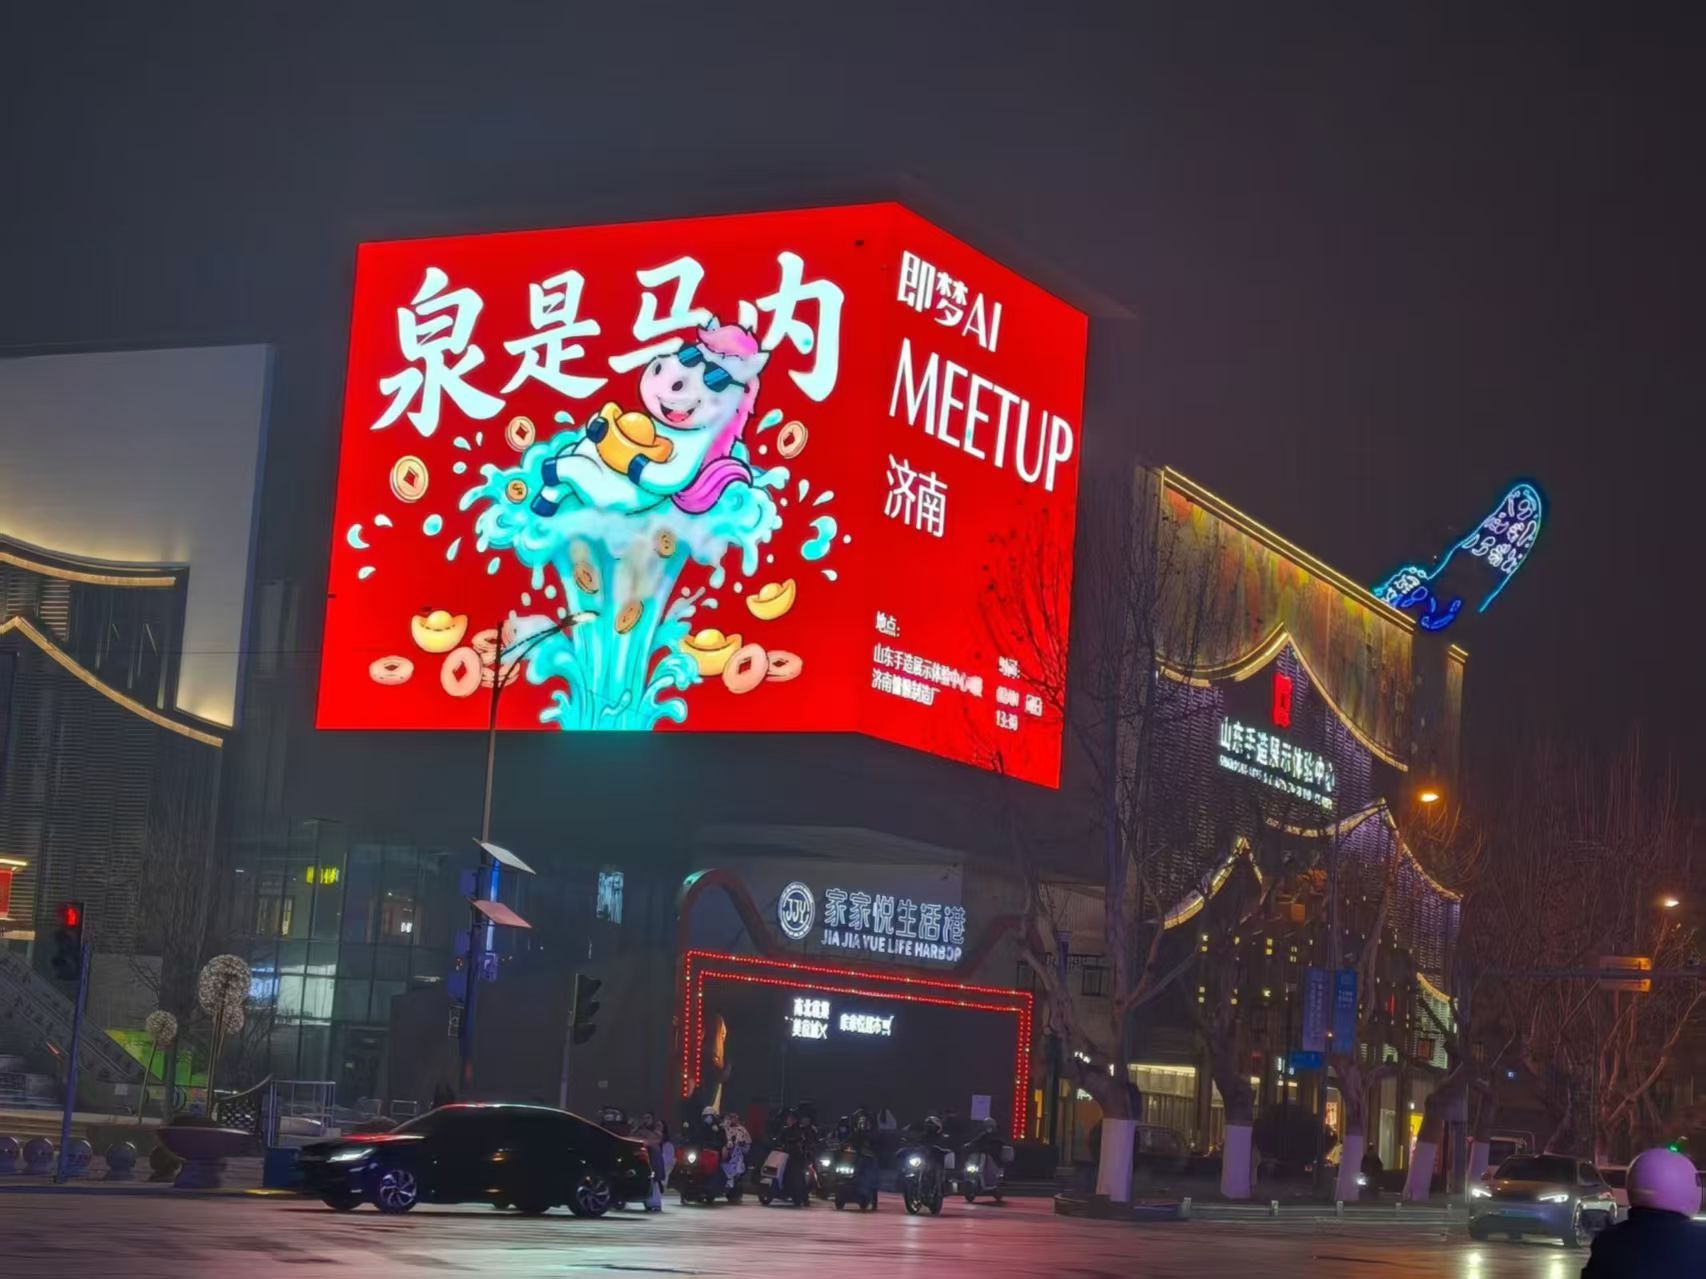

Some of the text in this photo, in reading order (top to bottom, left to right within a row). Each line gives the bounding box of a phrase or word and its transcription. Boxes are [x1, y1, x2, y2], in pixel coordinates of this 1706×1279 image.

[371, 251, 845, 437] 泉是马内
[897, 250, 1003, 353] 即梦AI
[889, 336, 1073, 492] MEETUP
[884, 453, 948, 538] 济南
[821, 929, 839, 946] JIA
[841, 932, 860, 949] JIA
[862, 935, 886, 953] YUE
[887, 938, 912, 956] LIFE
[824, 888, 966, 944] 家家悦生活港
